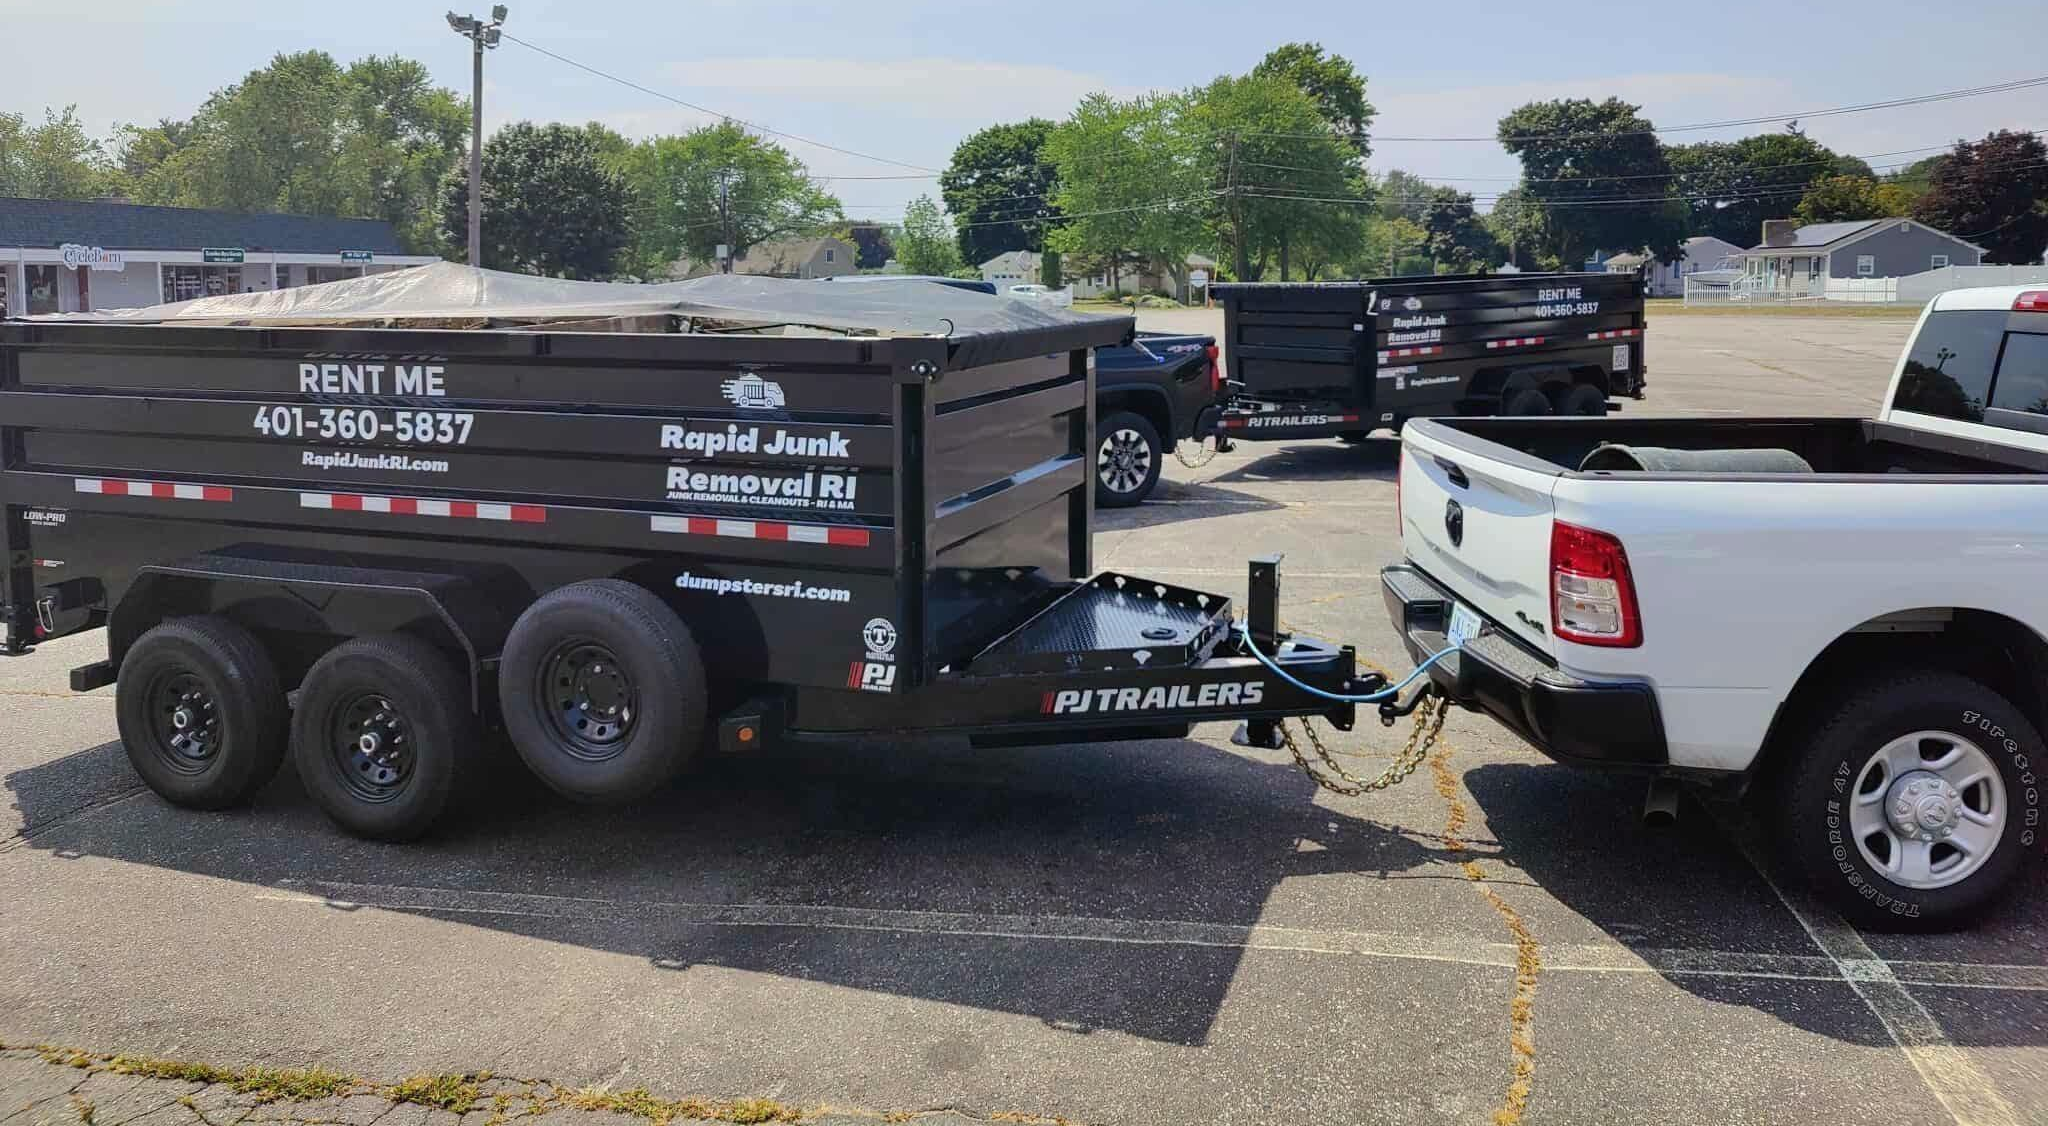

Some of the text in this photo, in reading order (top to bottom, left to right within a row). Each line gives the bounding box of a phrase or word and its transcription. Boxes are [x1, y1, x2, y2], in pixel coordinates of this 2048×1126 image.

[1538, 287, 1581, 301] RENT ME
[1535, 302, 1599, 318] 401-360-5837
[1393, 314, 1446, 329] Rapid Junk
[1388, 330, 1429, 342] Removal
[299, 363, 446, 396] RENT ME
[253, 406, 474, 444] 401-360-5837
[1248, 415, 1327, 427] PJ TRAILERS
[660, 424, 850, 458] Rapid Junk
[302, 451, 449, 472] RapidJunkRI.com
[666, 466, 857, 499] Removal RI
[666, 491, 693, 500] JUNK
[693, 492, 740, 503] REMOVAL
[741, 495, 748, 503] &
[749, 495, 809, 507] CLEANOUTS
[816, 500, 828, 508] RI
[837, 501, 855, 510] MA
[24, 511, 66, 522] LOW-PRO
[675, 571, 851, 602] dumpstersri.com
[862, 662, 897, 686] PJ
[1054, 681, 1265, 714] PJ TRAILERS
[1827, 761, 1921, 918] TRANSFORCE AT
